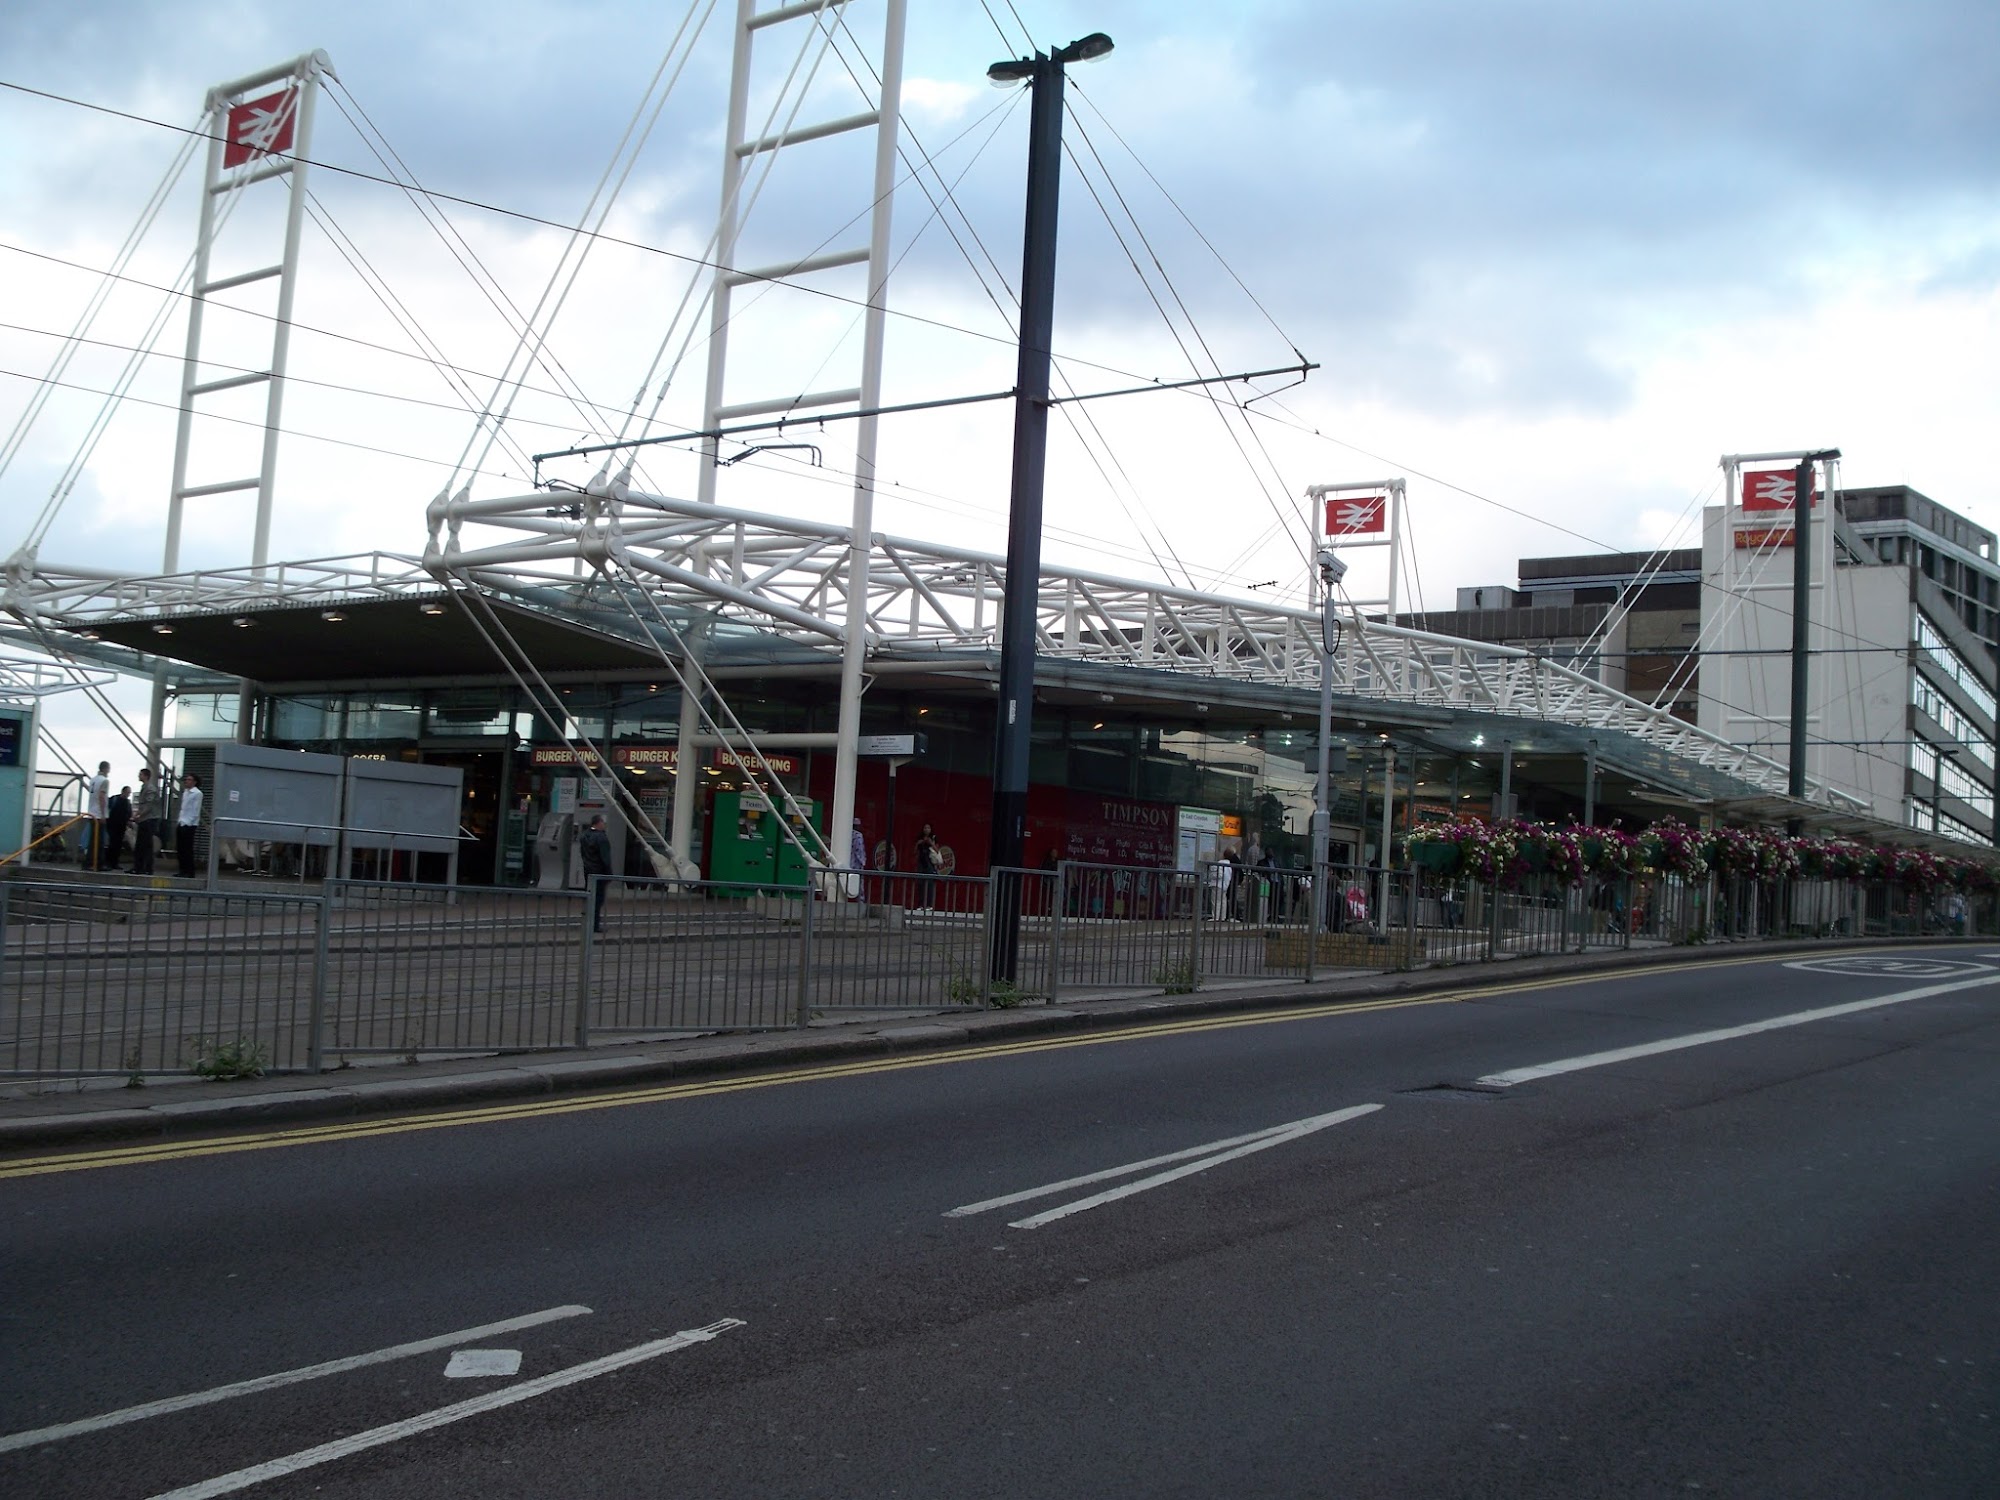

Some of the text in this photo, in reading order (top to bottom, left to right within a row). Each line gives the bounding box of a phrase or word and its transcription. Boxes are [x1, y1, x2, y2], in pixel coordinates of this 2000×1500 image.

[1735, 532, 1768, 546] Royal
[535, 750, 572, 762] BURGER
[629, 750, 669, 763] BURGER
[641, 797, 667, 807] SAUCY!
[745, 801, 763, 809] Tickets
[1102, 802, 1170, 826] TIMPSON
